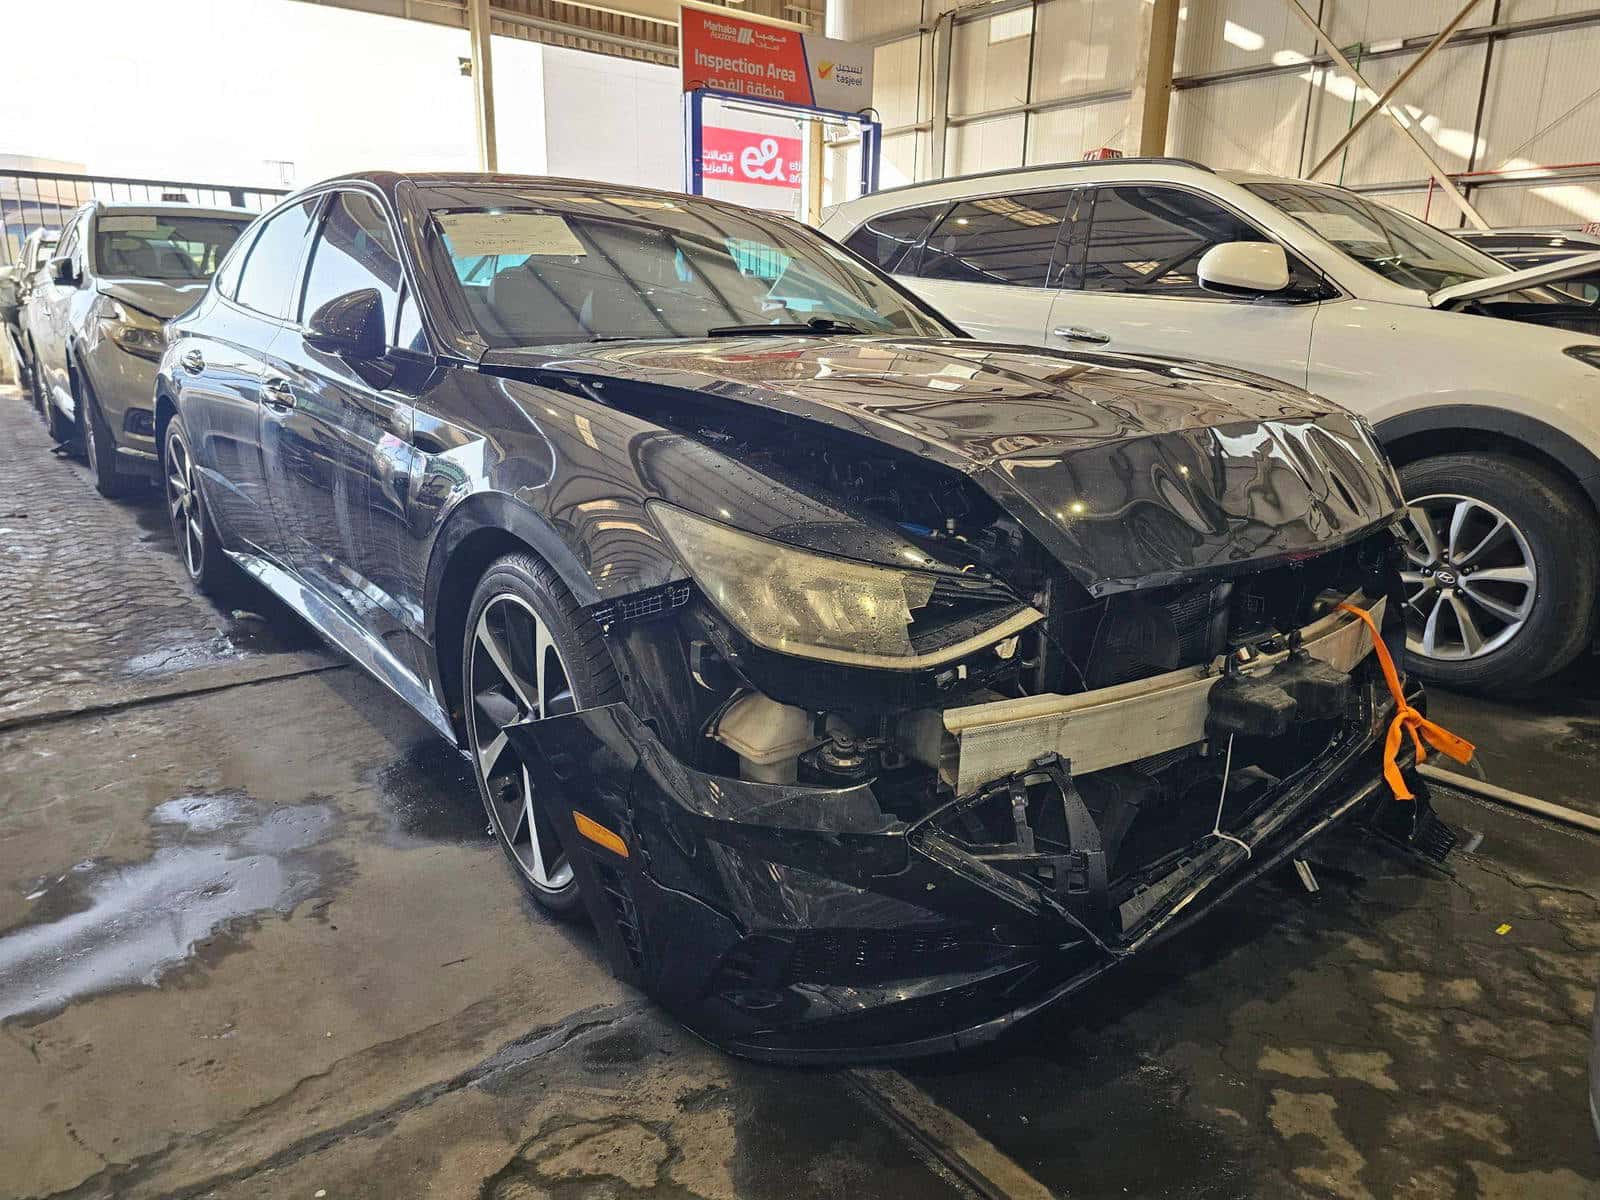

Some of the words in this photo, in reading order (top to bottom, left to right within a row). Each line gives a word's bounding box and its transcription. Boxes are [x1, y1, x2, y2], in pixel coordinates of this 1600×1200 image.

[703, 19, 737, 34] Marhaba
[710, 30, 737, 43] Auctions
[694, 48, 764, 76] Inspection
[767, 63, 796, 82] Area
[836, 74, 863, 86] tasjeel
[746, 80, 785, 100] منطقة
